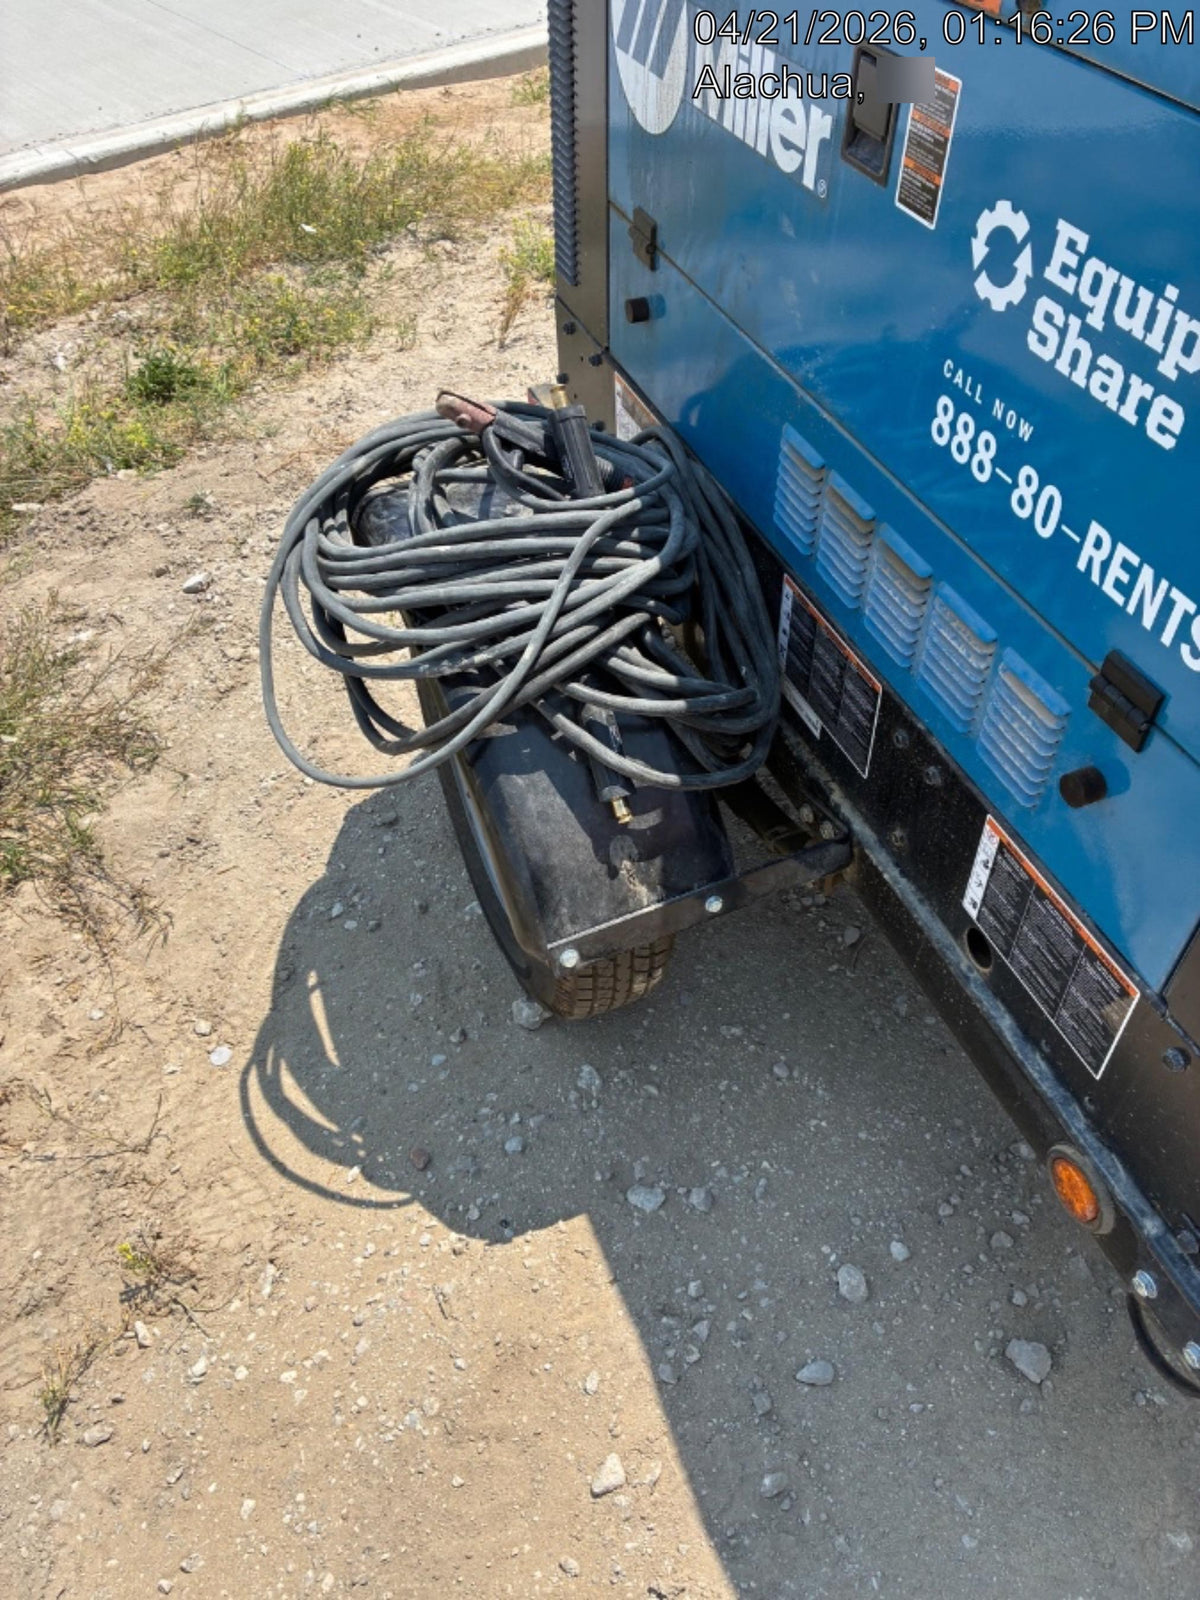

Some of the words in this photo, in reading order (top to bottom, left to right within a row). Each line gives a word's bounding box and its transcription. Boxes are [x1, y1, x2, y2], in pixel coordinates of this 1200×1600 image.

[693, 8, 833, 192] Miller
[1027, 295, 1185, 450] Share
[1043, 218, 1200, 381] Equip
[943, 359, 983, 404] CALL
[992, 398, 1034, 442] NOW
